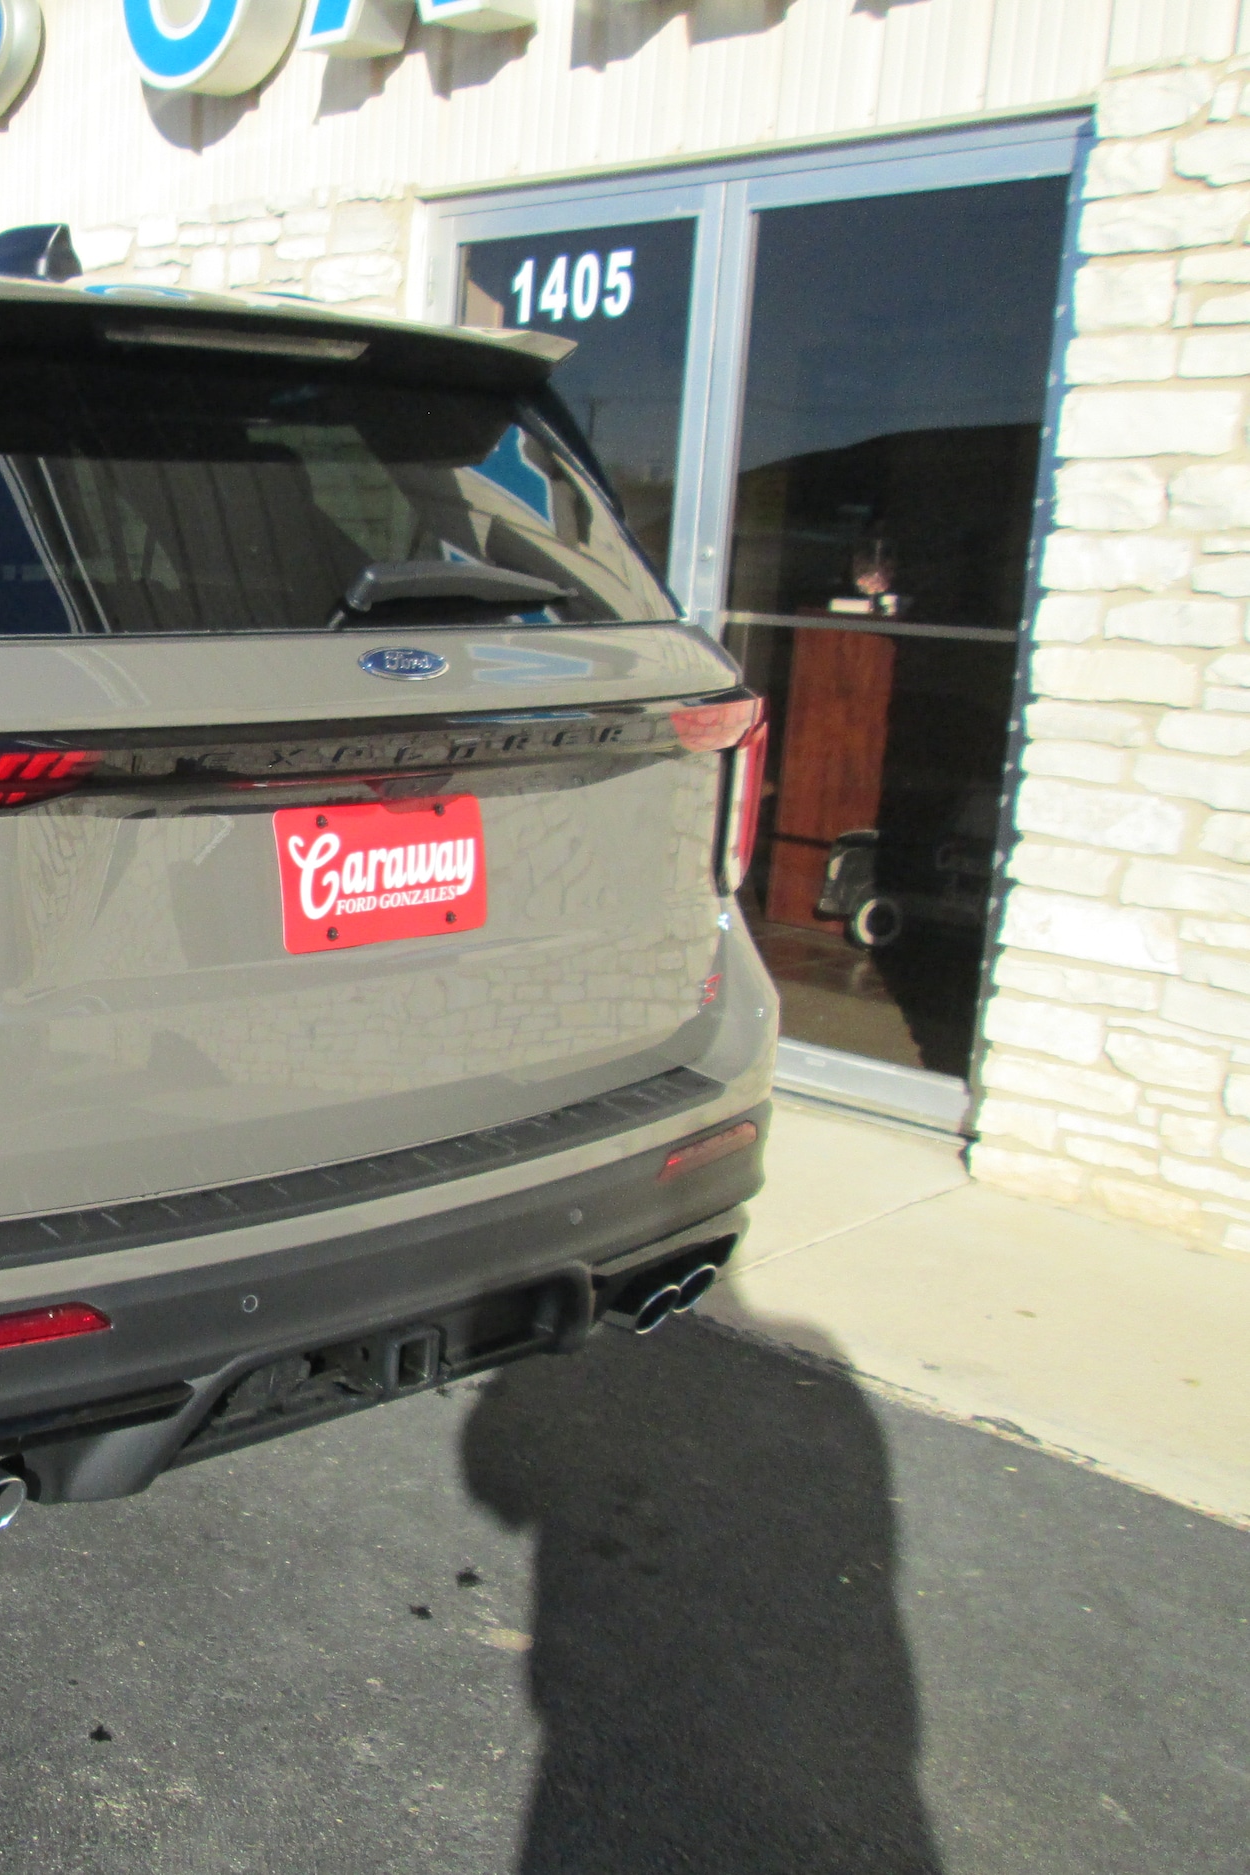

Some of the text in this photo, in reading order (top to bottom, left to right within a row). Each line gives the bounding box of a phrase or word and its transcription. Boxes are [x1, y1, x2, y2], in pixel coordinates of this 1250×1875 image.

[511, 248, 634, 325] 1405
[384, 650, 433, 671] Ford
[288, 832, 476, 920] Caraway
[335, 885, 457, 916] FORD GONZALES
